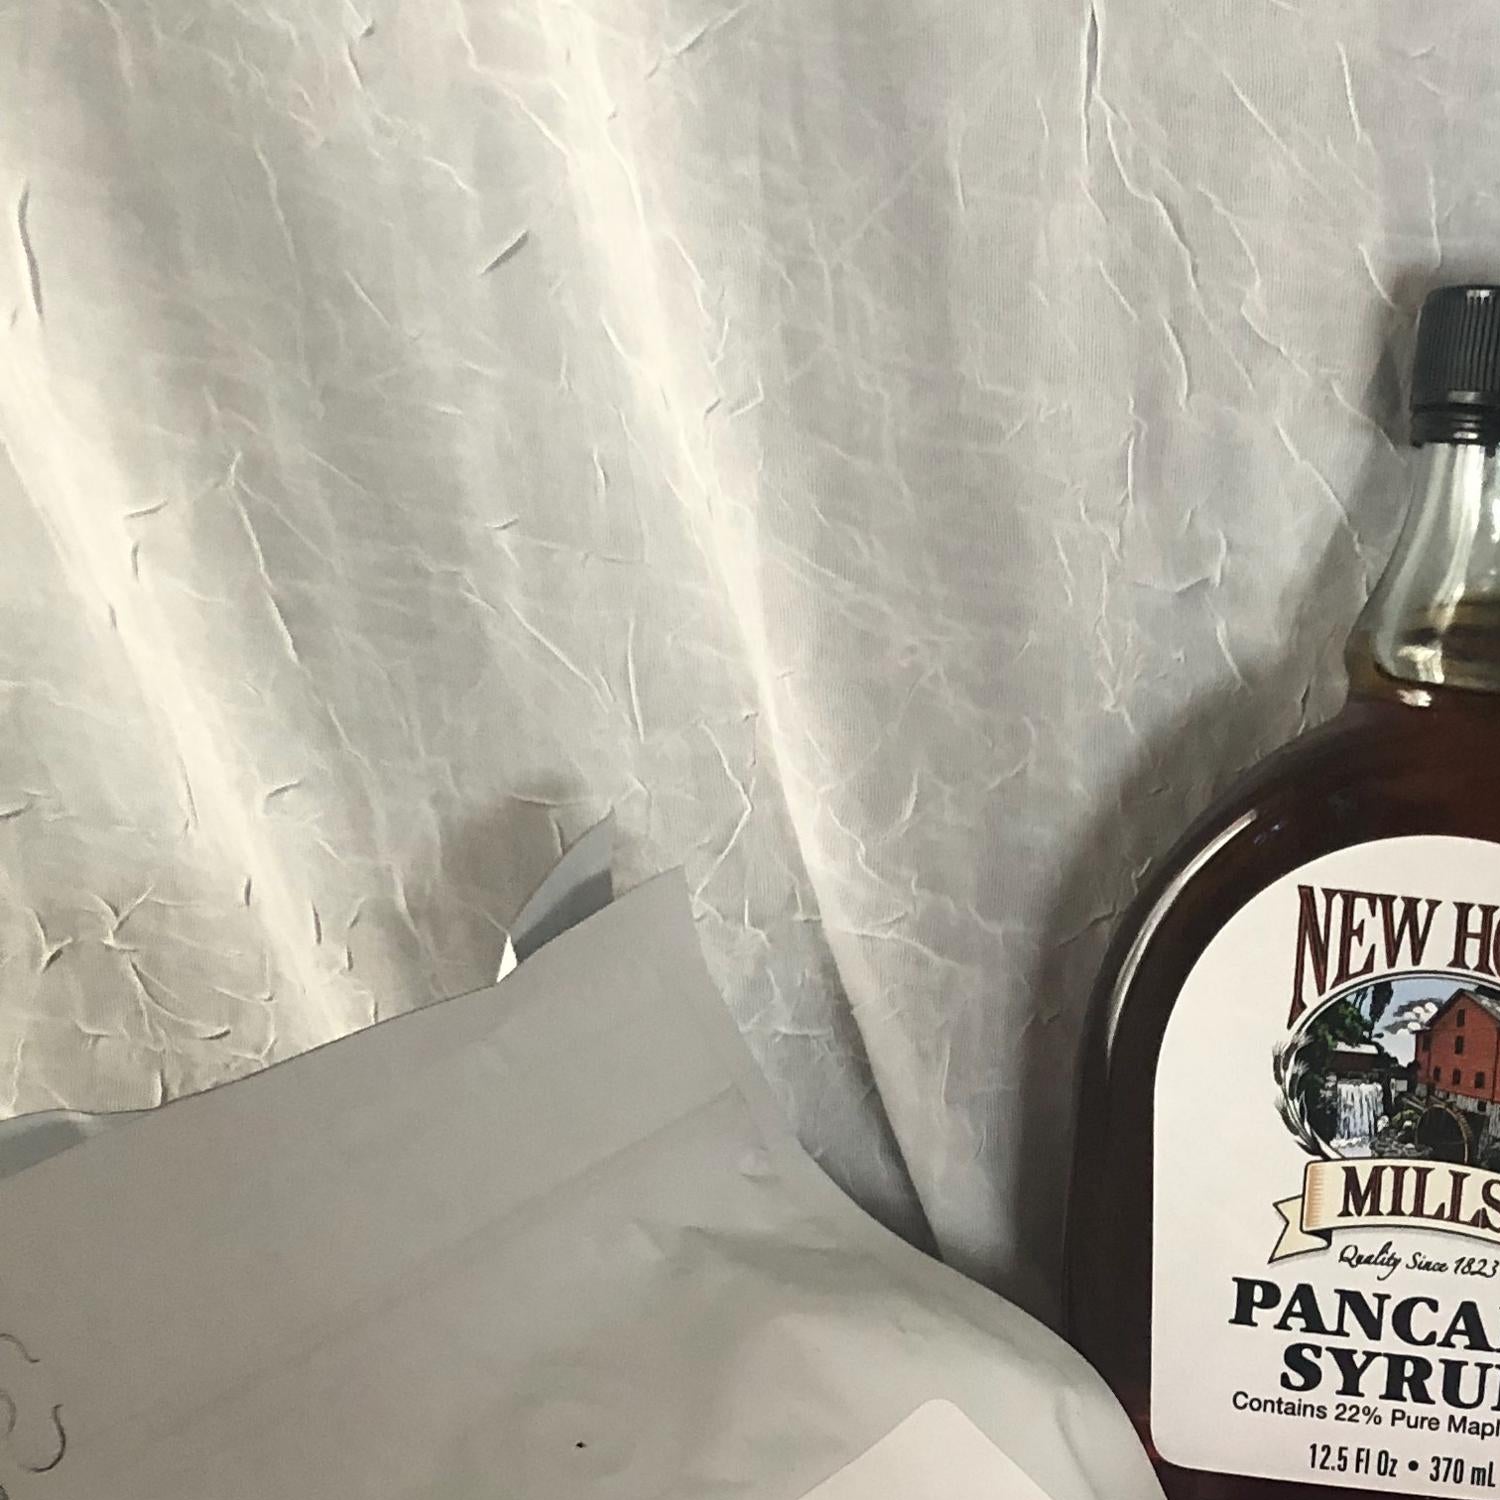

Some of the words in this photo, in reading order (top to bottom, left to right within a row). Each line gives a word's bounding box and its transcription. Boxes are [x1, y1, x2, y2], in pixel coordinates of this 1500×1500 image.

[1287, 885, 1442, 1030] NEW
[1338, 1241, 1402, 1281] Quality
[1406, 1252, 1448, 1273] Since
[1454, 1257, 1500, 1278] 1823
[1232, 1391, 1327, 1419] Contains
[1334, 1403, 1382, 1425] 22%
[1391, 1409, 1440, 1431] Pure
[1309, 1443, 1348, 1472] 12.5
[1355, 1448, 1370, 1474] Fl
[1377, 1450, 1397, 1477] Oz
[1429, 1456, 1464, 1484] 370
[1470, 1461, 1496, 1487] mL
